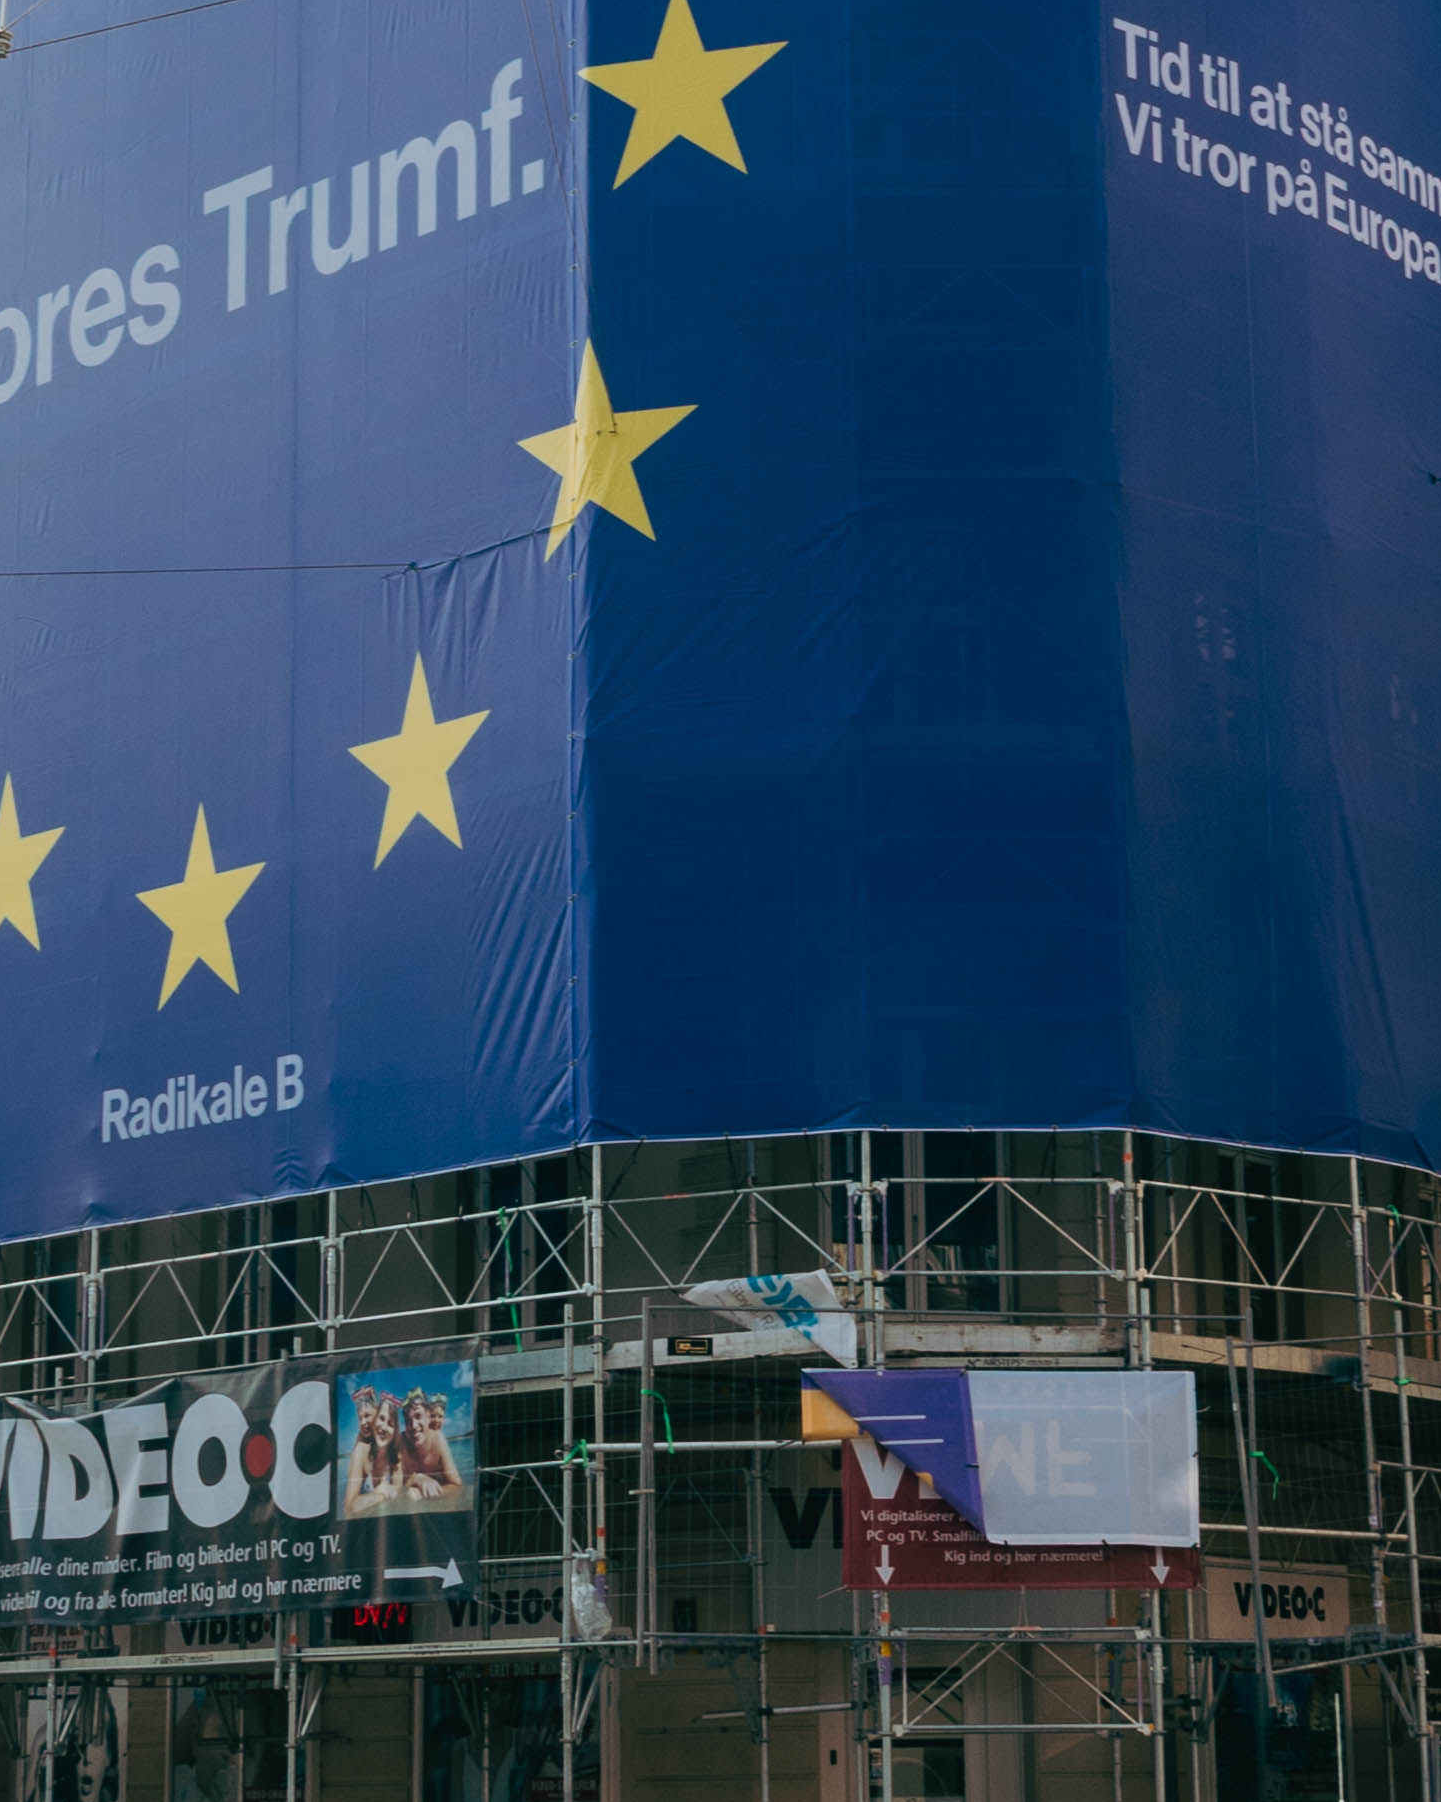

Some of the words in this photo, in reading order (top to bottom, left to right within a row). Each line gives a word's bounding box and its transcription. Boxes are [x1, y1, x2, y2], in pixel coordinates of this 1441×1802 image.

[1113, 17, 1191, 100] Tid
[1199, 52, 1241, 117] til
[1250, 81, 1294, 136] at
[1300, 101, 1355, 167] stå
[1114, 92, 1164, 164] Vi
[1171, 117, 1257, 195] tror
[1265, 158, 1320, 220] på
[203, 57, 546, 313] Trumf.
[101, 1064, 269, 1143] Radikale
[276, 1054, 306, 1111] B
[860, 1509, 875, 1522] Vi
[877, 1508, 956, 1525] digitaliserer
[866, 1530, 884, 1542] PC
[887, 1531, 905, 1546] og
[908, 1529, 928, 1542] TV.
[22, 1556, 52, 1576] alle
[57, 1557, 89, 1577] dine
[146, 1549, 172, 1571] Film
[176, 1552, 195, 1573] og
[198, 1542, 251, 1566] billeder
[255, 1540, 268, 1561] til
[271, 1538, 289, 1559] PC
[292, 1541, 314, 1562] og
[319, 1534, 342, 1555] TV.
[944, 1550, 967, 1565] Kig
[969, 1550, 990, 1563] ind
[993, 1552, 1011, 1566] og
[1014, 1550, 1036, 1563] hør
[1039, 1549, 1104, 1563] nærmere!
[44, 1594, 70, 1616] og
[74, 1591, 94, 1610] fra
[121, 1583, 188, 1608] formater!
[190, 1582, 214, 1607] Kig
[216, 1579, 237, 1600] ind
[241, 1582, 263, 1603] og
[266, 1575, 286, 1597] hør
[291, 1573, 363, 1594] nærmere
